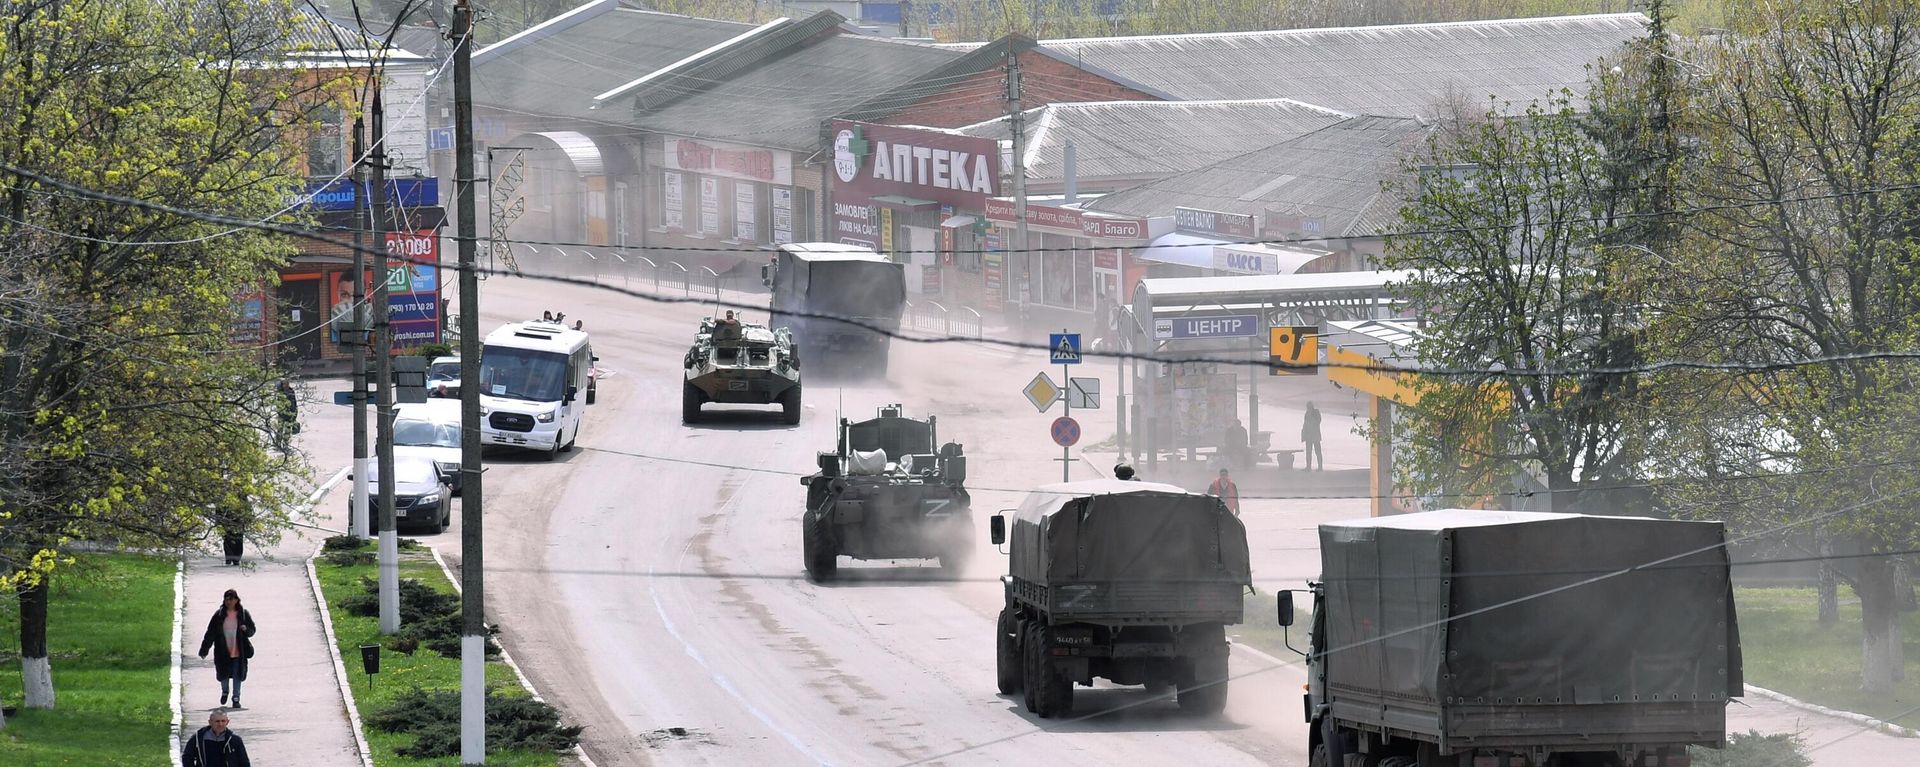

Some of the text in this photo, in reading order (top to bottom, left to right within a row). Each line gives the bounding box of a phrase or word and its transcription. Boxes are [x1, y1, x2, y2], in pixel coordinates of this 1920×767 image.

[873, 141, 992, 194] АПТЕКА
[1104, 223, 1136, 236] Благо
[404, 303, 417, 312] 170
[426, 302, 434, 310] 20
[1187, 319, 1242, 336] ЦЕНТР
[926, 499, 951, 517] Z
